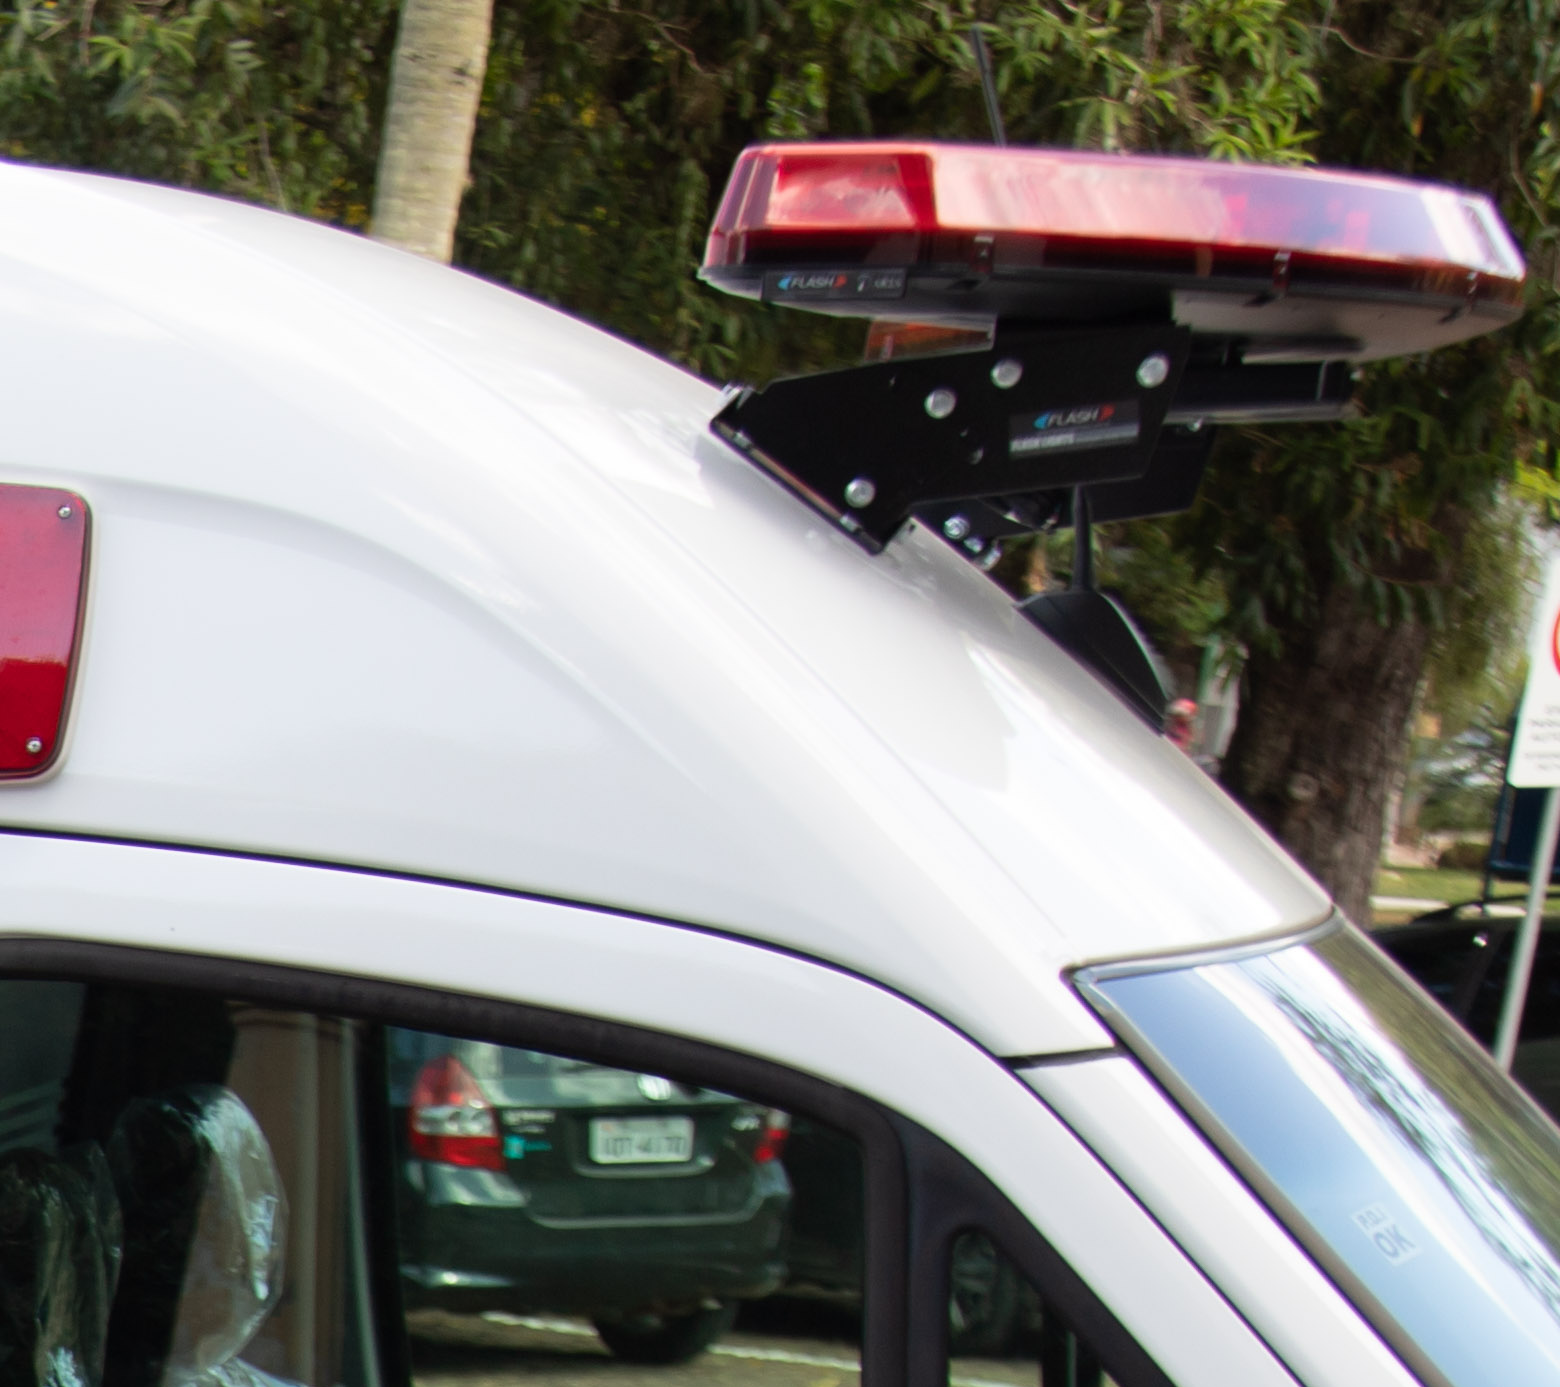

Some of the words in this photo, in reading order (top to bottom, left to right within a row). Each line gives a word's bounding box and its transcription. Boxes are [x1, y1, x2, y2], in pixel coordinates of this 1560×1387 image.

[790, 275, 836, 289] FLASH
[1048, 408, 1100, 427] FLASH
[1373, 1223, 1417, 1259] OK
